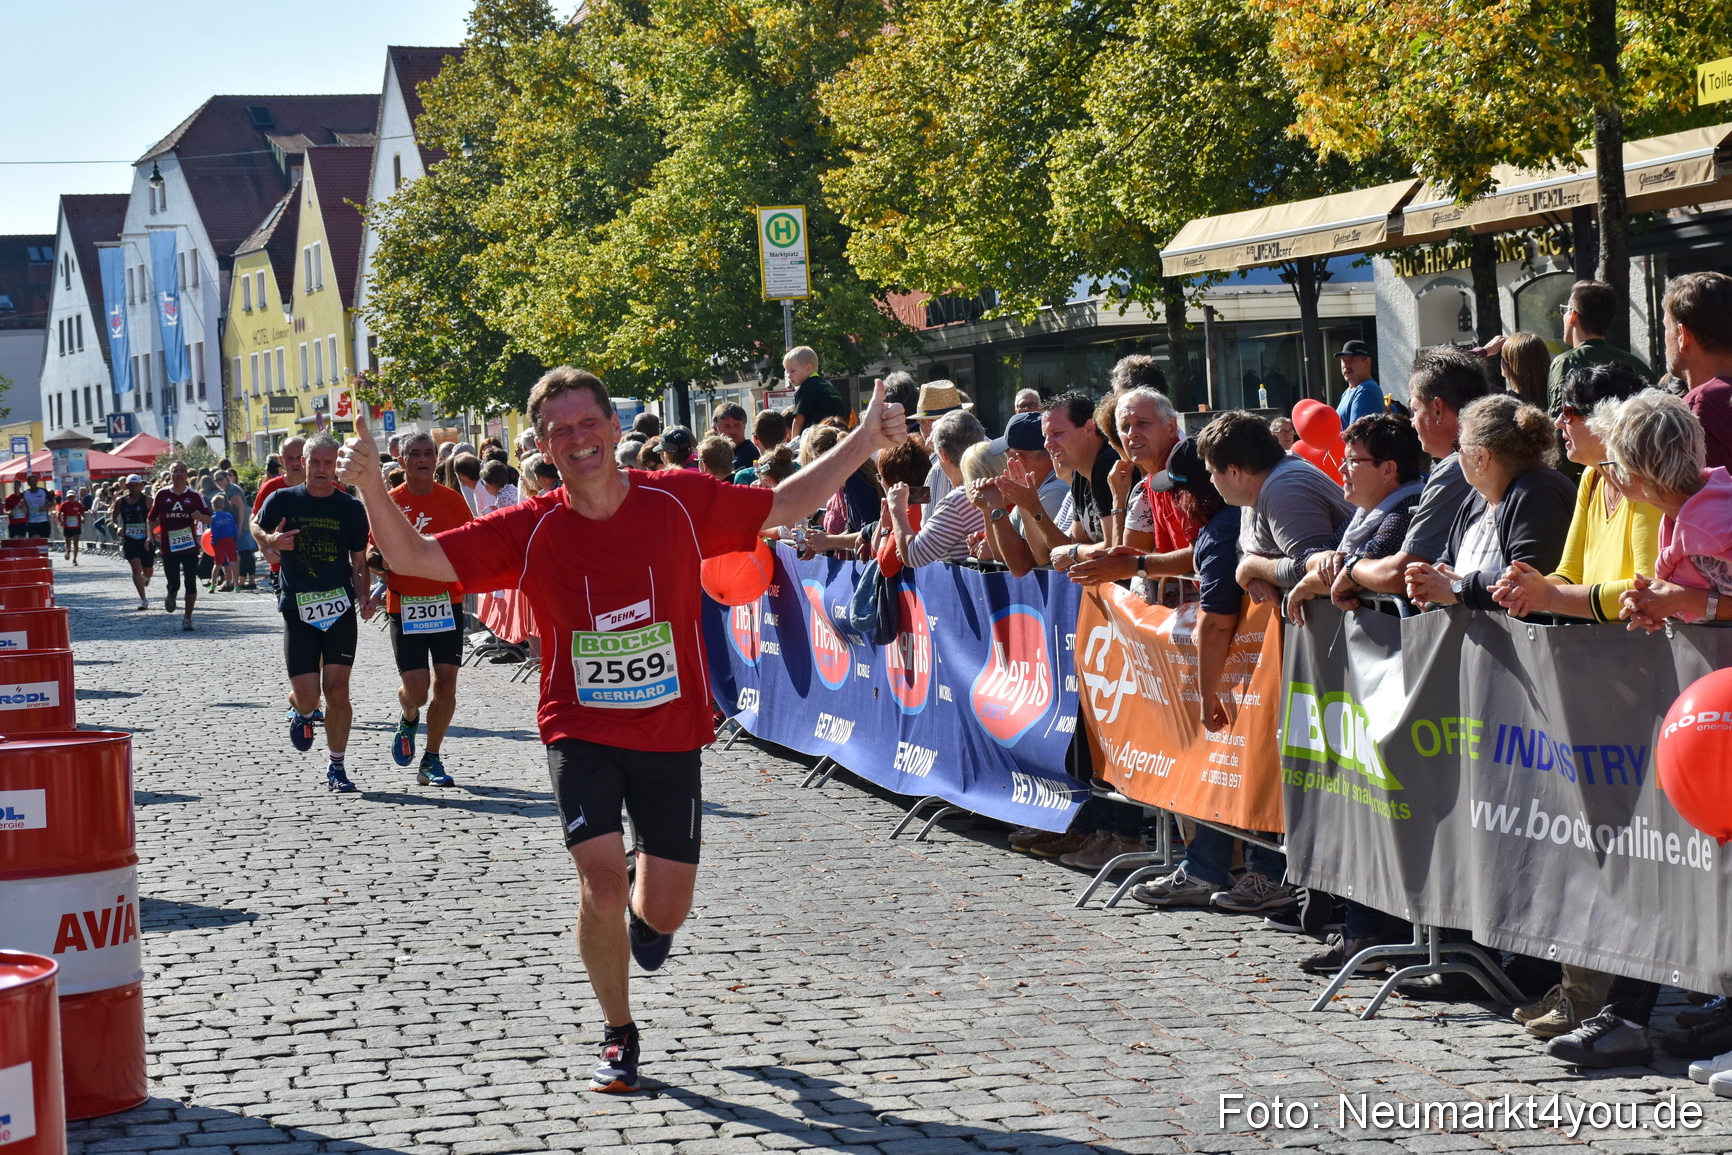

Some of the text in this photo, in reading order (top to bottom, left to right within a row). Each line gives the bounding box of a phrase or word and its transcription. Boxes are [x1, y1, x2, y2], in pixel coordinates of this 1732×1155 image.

[172, 535, 191, 545] 2786
[305, 600, 346, 621] 2120
[407, 603, 446, 620] 2301
[611, 609, 636, 624] DEHN
[413, 621, 444, 629] ROBERT
[580, 625, 664, 655] BOCK
[761, 641, 780, 655] MOBILE
[586, 652, 665, 684] 2569
[979, 640, 1049, 716] Hervis
[592, 684, 666, 701] GERHARD
[1117, 740, 1176, 779] Agentur
[1493, 723, 1647, 787] INDUSTRY
[1012, 771, 1033, 804] GET
